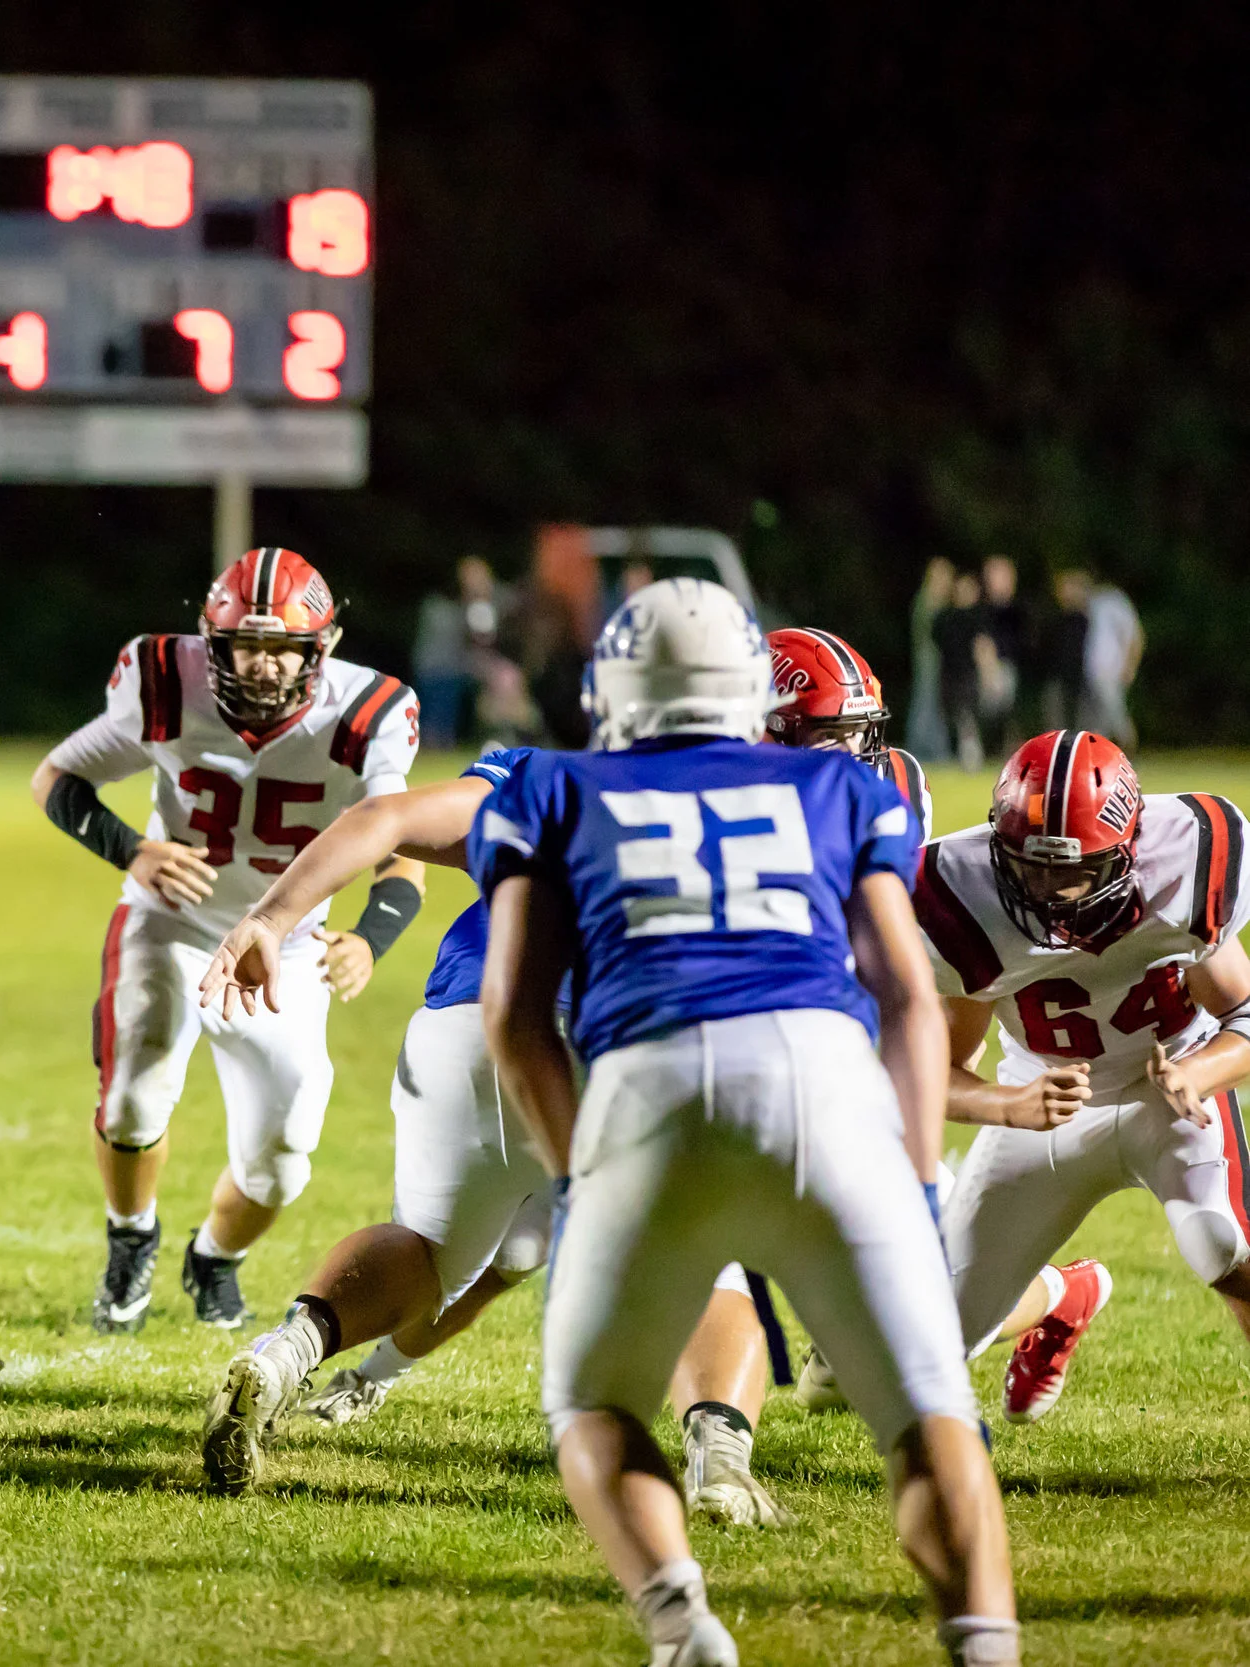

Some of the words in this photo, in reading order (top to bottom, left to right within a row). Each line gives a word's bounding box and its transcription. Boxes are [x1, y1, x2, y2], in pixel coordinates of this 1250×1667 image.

[173, 308, 235, 394] 7
[282, 310, 346, 401] 2
[179, 766, 324, 875] 35
[600, 783, 814, 939] 32
[1014, 960, 1197, 1059] 64
